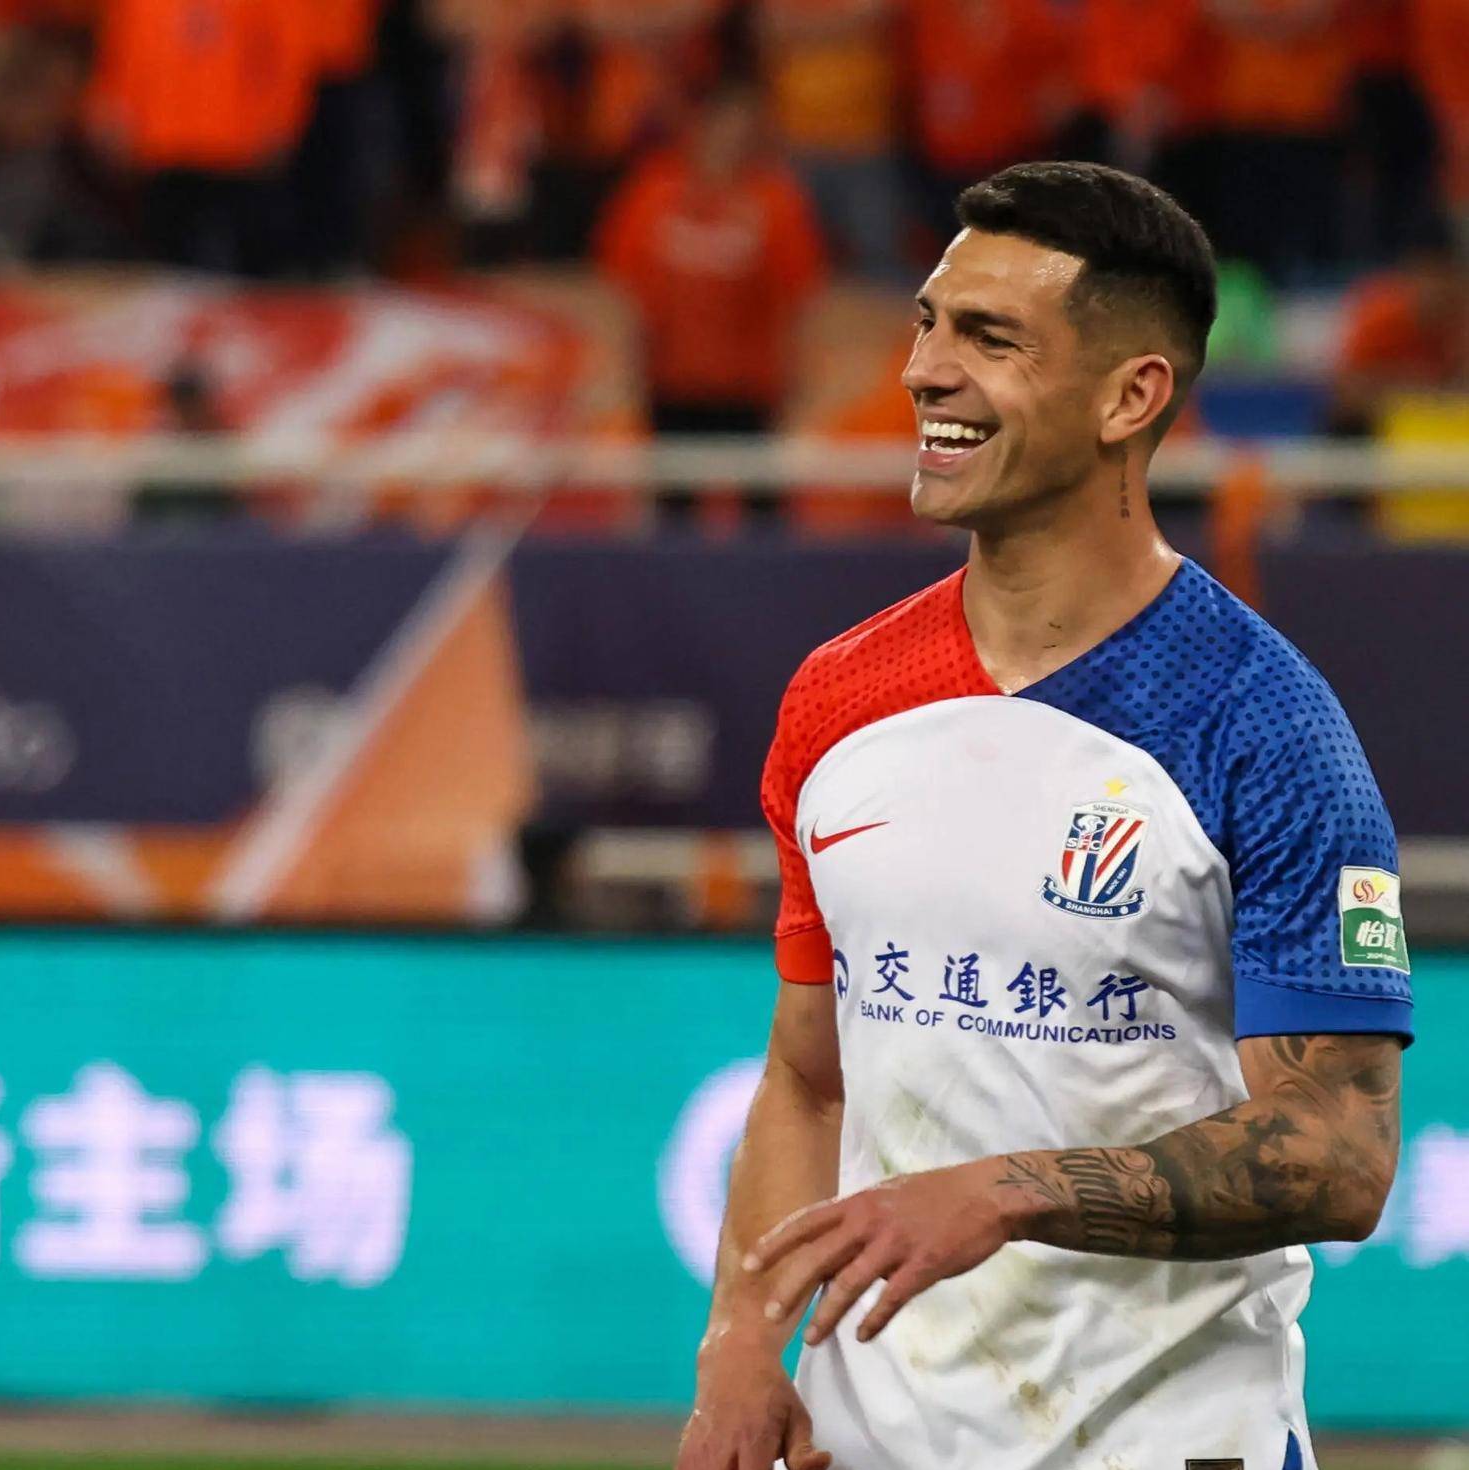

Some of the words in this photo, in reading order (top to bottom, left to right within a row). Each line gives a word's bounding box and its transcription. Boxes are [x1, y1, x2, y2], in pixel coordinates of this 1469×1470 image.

[1066, 837, 1102, 851] SFC
[1065, 902, 1114, 916] SHANGHAI
[871, 941, 1150, 1022] 交通銀行
[861, 1000, 904, 1023] BANK
[916, 1009, 945, 1027] OF
[957, 1014, 1177, 1044] COMMUNICATIONS
